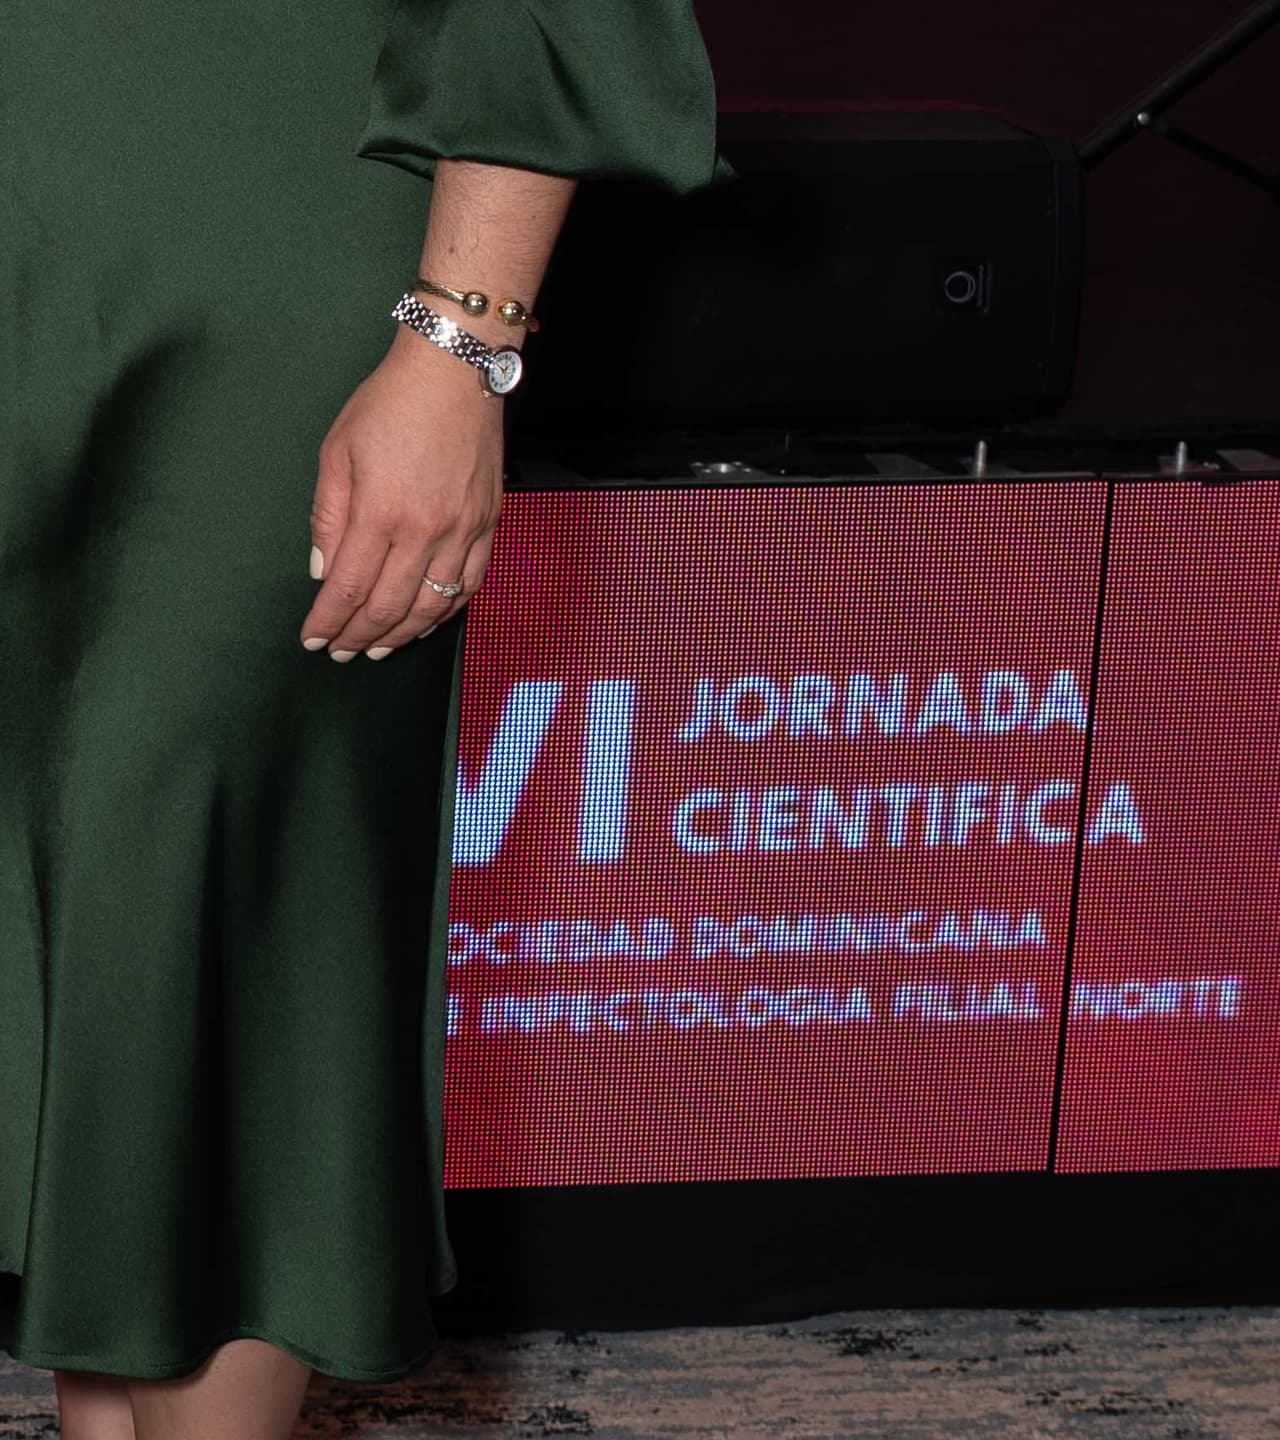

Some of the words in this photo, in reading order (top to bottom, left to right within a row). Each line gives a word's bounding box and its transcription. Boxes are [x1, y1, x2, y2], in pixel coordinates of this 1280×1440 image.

[674, 670, 1090, 741] JORNADA
[672, 780, 1144, 854] CIENTIFICA
[447, 918, 675, 965] OCIEDAD
[696, 910, 1045, 960] DOMINICANA
[480, 986, 872, 1033] INFECTOLOGIA
[893, 981, 1040, 1021] FILIAL
[1072, 976, 1240, 1020] NORTE
